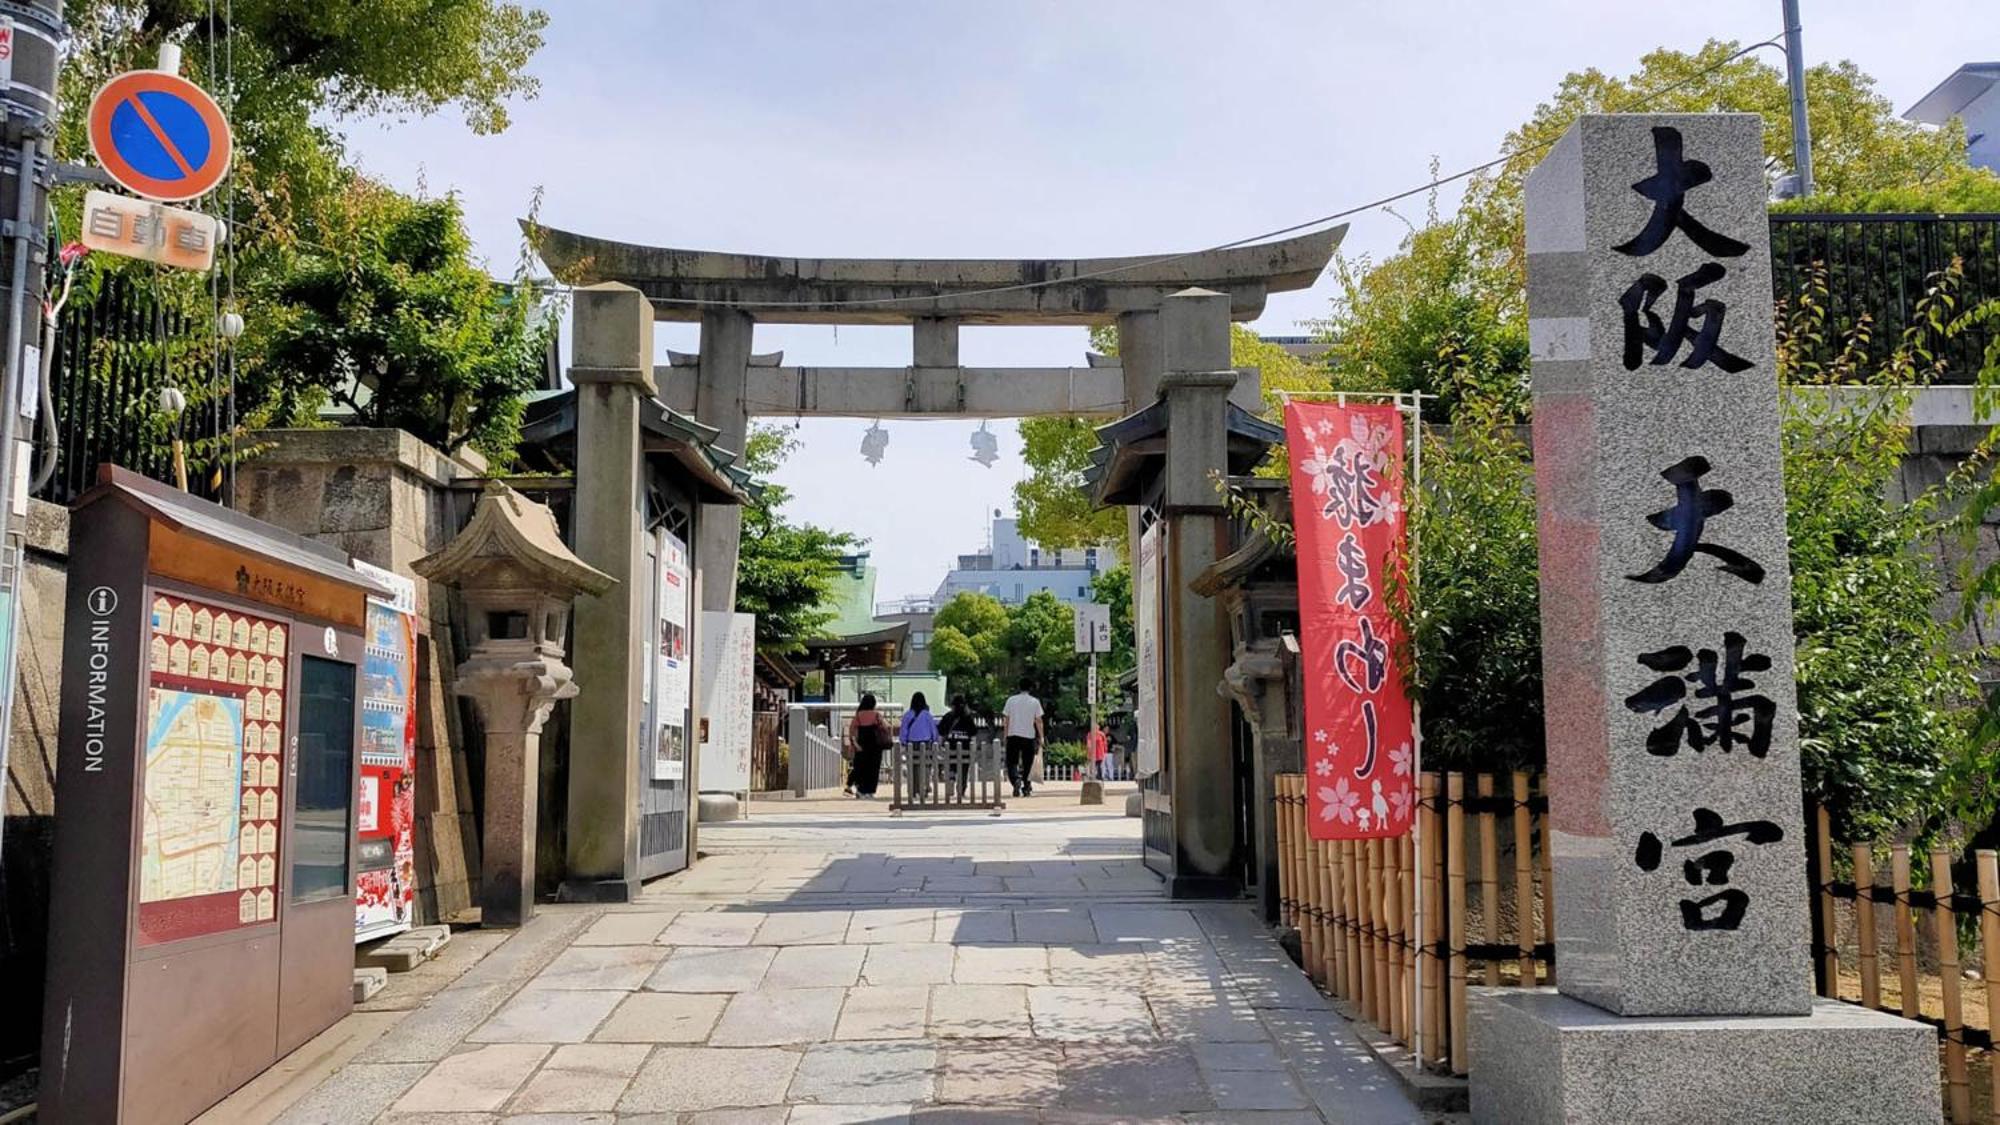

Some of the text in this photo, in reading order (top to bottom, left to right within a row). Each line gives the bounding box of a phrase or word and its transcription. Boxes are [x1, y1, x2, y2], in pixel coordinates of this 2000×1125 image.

[89, 207, 207, 254] 自動車
[1611, 126, 1784, 930] 大阪天満宮
[1098, 622, 1108, 641] 出口
[85, 620, 108, 772] INFORMATION
